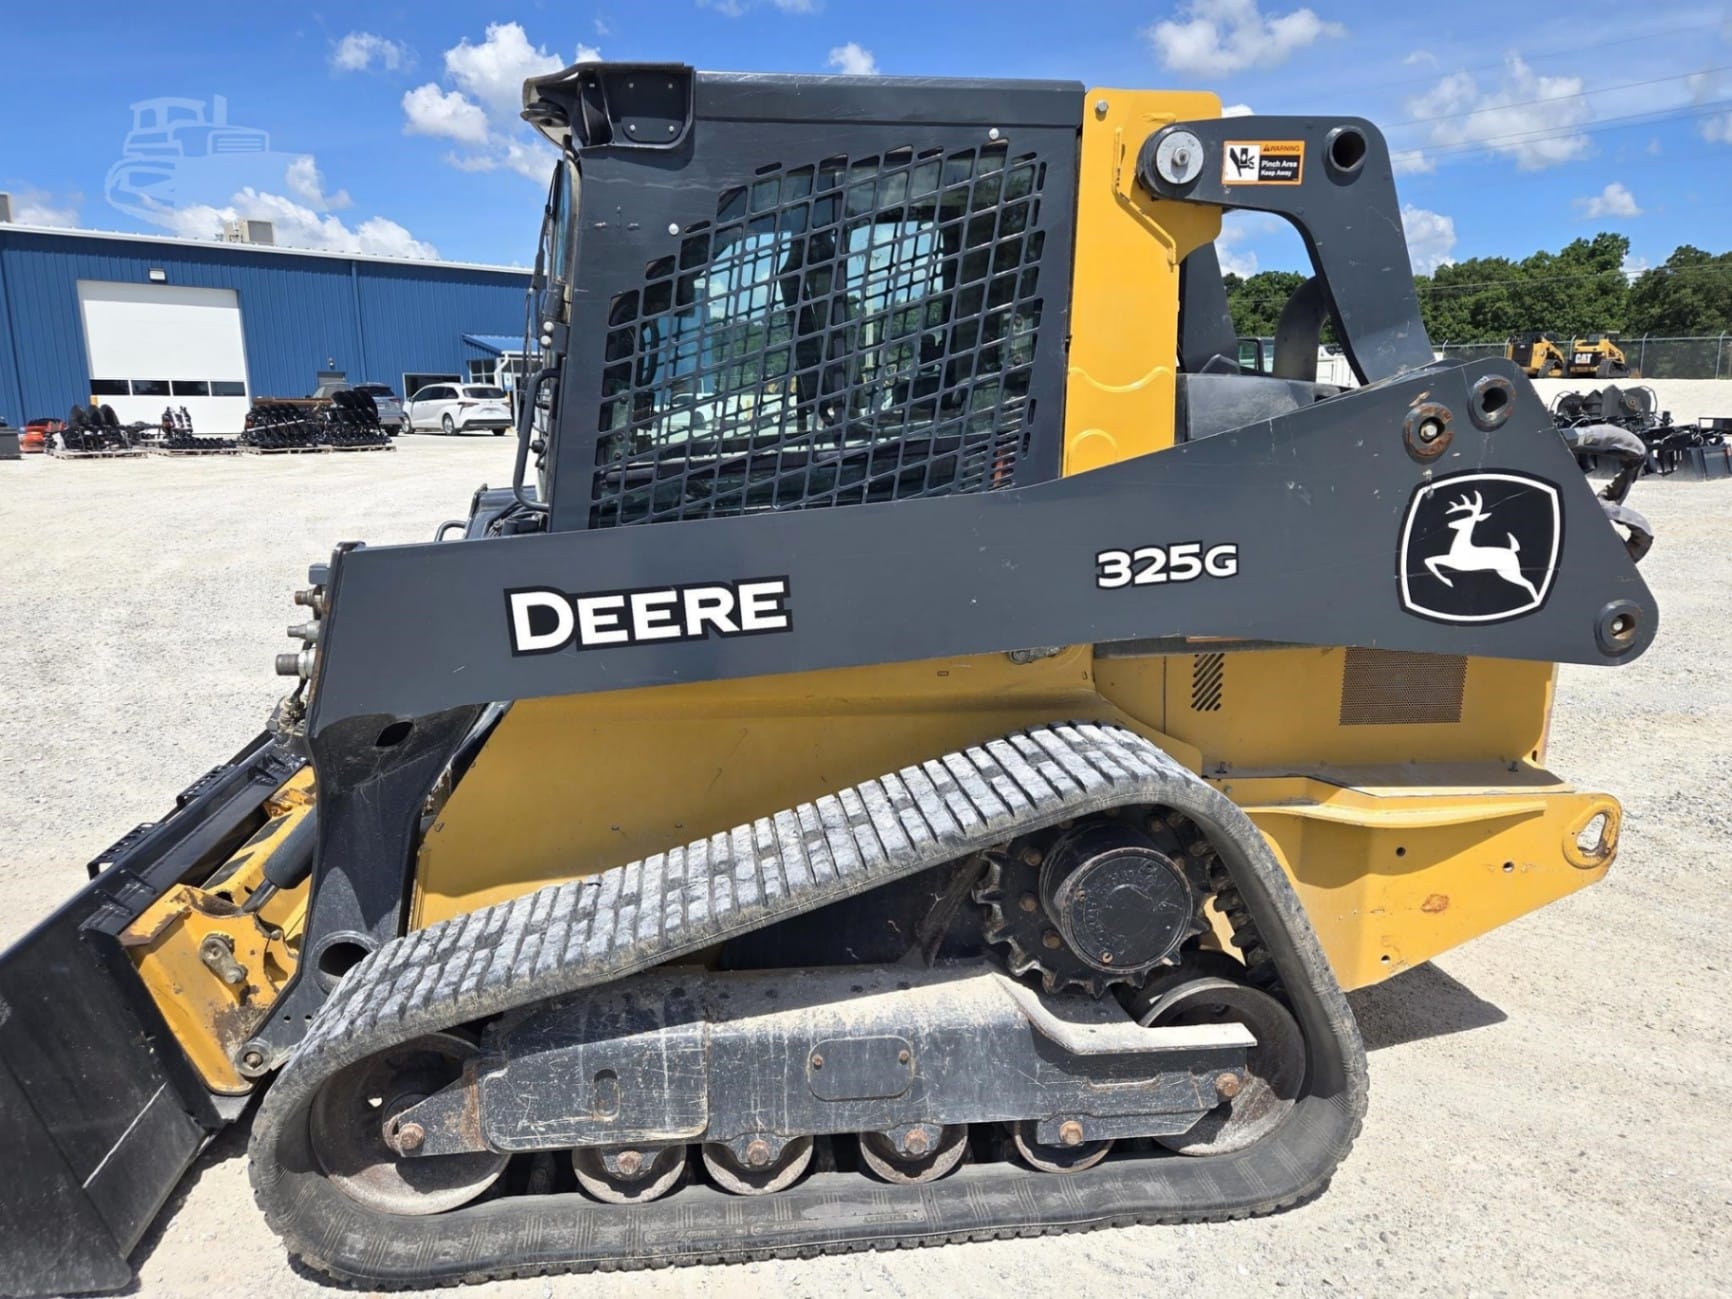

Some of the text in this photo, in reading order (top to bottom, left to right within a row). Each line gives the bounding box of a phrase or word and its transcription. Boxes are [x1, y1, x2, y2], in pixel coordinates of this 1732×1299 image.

[1261, 160, 1298, 168] Pinch Area
[1276, 169, 1292, 177] Away
[1575, 353, 1593, 364] CAT
[1097, 542, 1238, 589] 325G
[509, 580, 788, 651] DEERE
